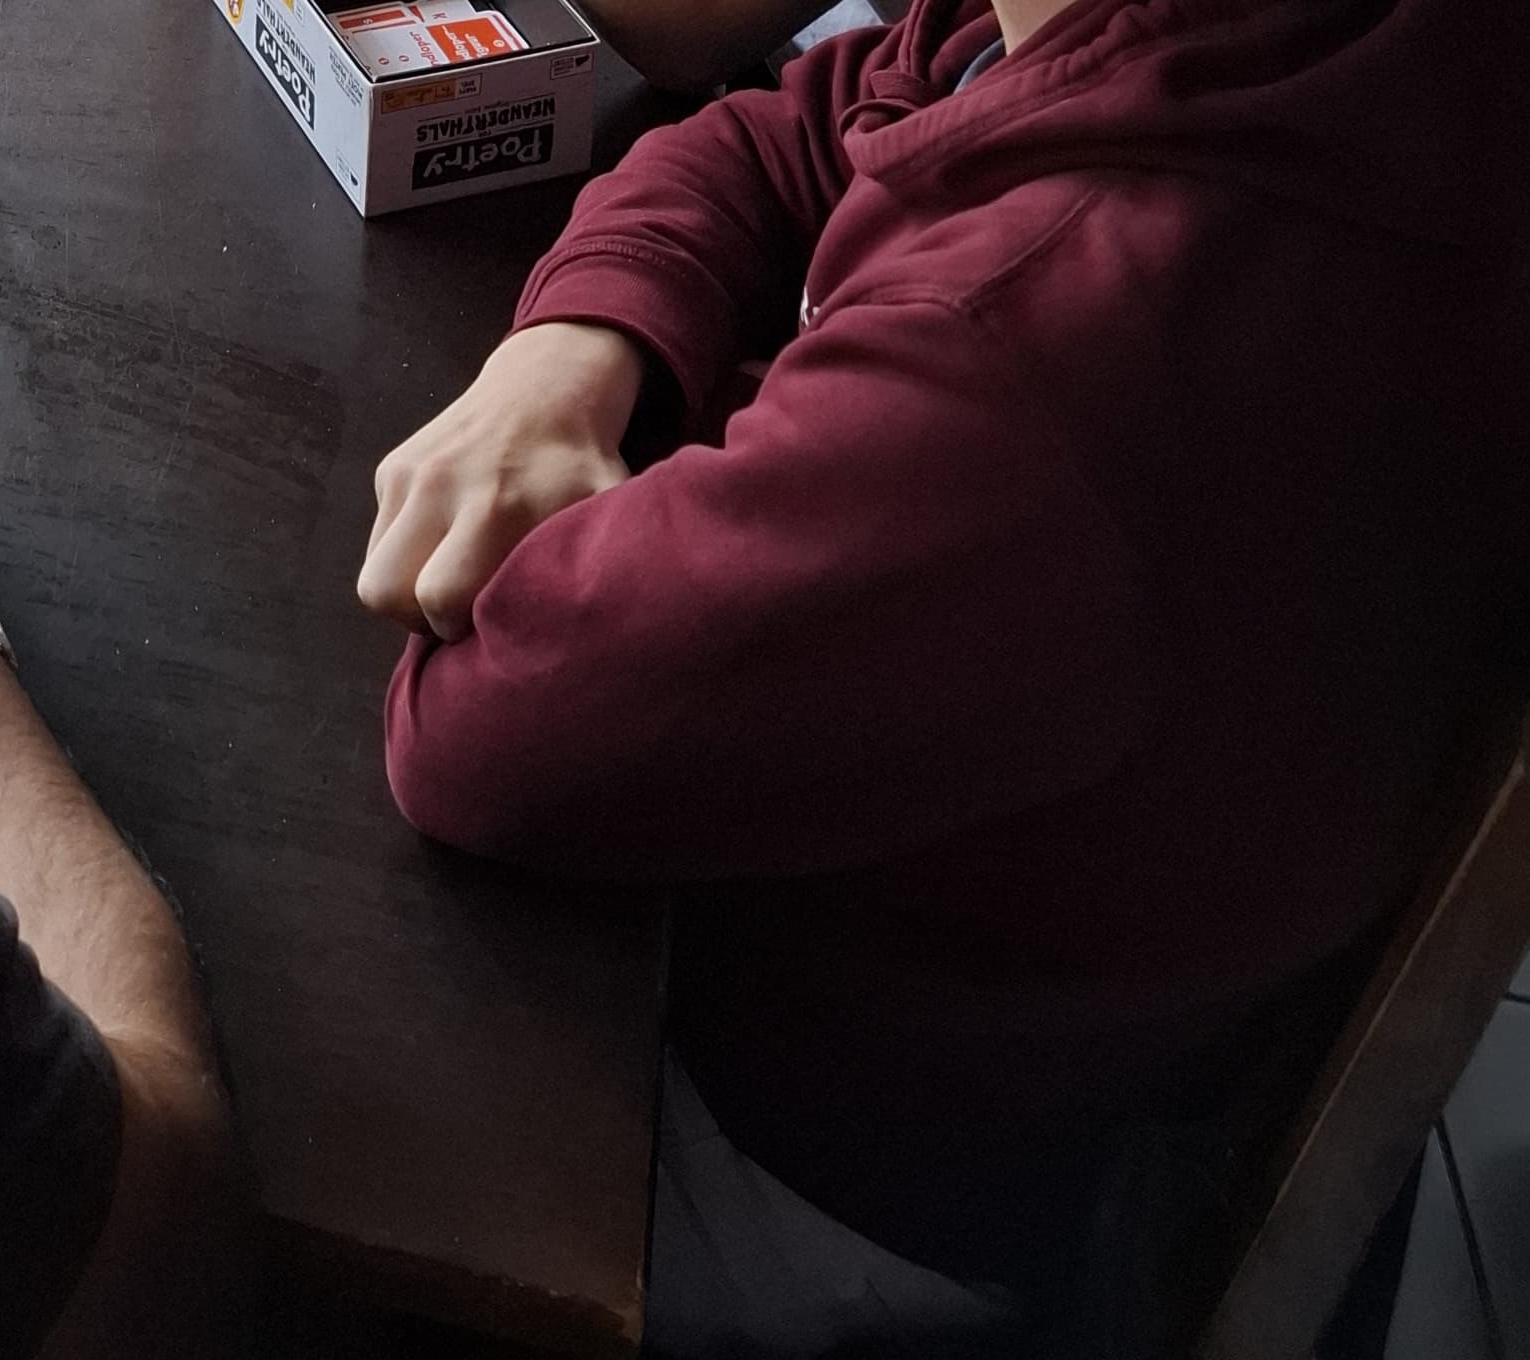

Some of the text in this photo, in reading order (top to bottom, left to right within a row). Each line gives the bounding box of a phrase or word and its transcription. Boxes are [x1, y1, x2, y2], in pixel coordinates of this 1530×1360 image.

[258, 26, 312, 122] Poetry
[415, 97, 555, 142] NEANDERTHALS
[422, 127, 542, 180] Poetry
